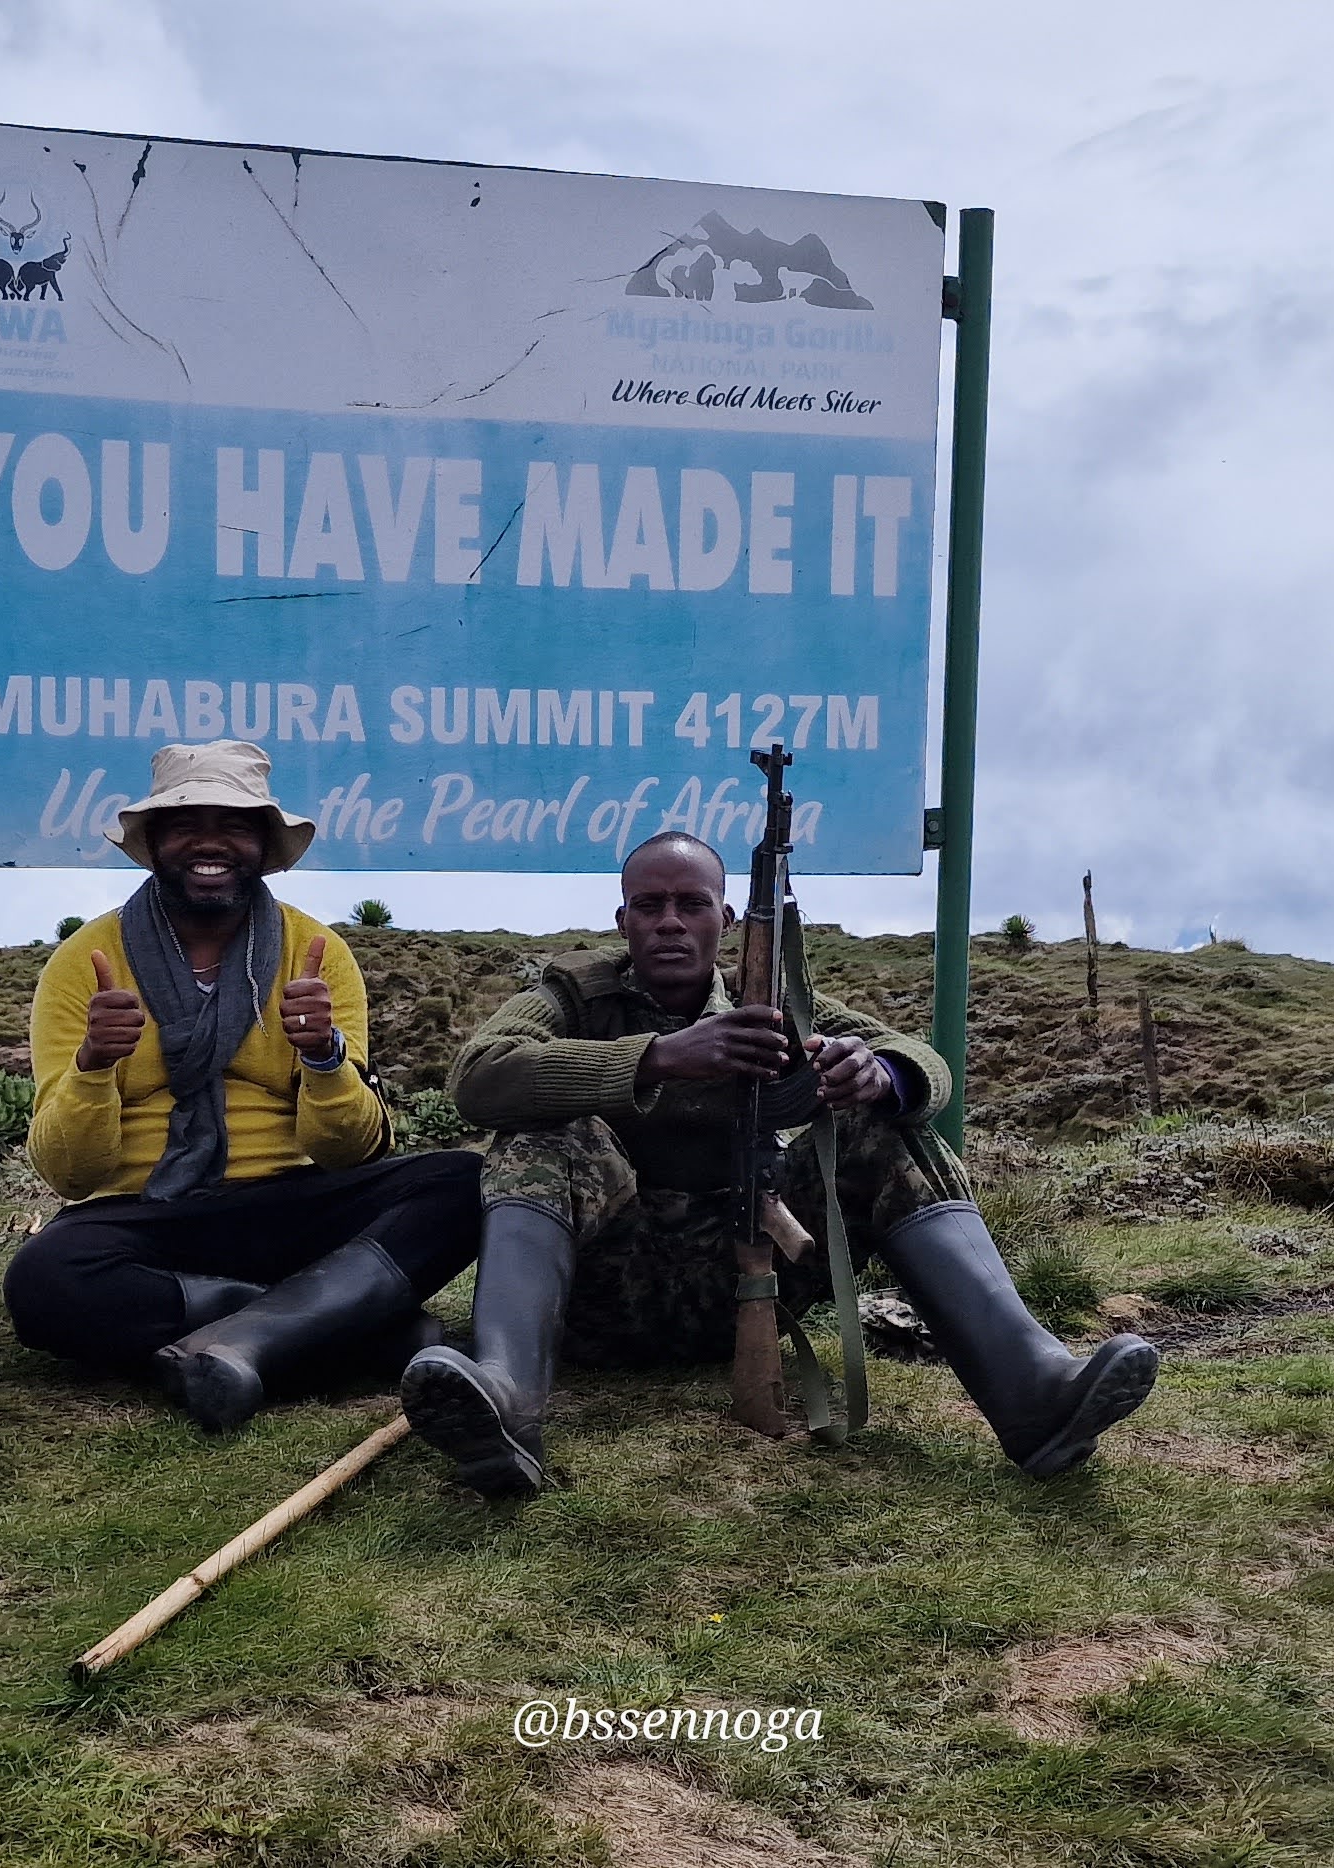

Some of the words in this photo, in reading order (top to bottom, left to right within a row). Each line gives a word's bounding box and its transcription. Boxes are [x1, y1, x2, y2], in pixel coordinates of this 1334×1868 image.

[606, 310, 775, 352] Mgahinga
[611, 379, 689, 405] Where
[695, 383, 751, 409] Gold
[750, 386, 817, 412] Meets
[820, 390, 882, 415] Silver
[216, 447, 483, 585] HAVE
[516, 461, 794, 595] MADE
[829, 475, 913, 597] IT
[390, 685, 654, 747] SUMMIT
[675, 693, 879, 750] 4127M
[319, 773, 403, 841] the
[422, 773, 590, 844] Pearl
[588, 776, 660, 863] of
[658, 775, 823, 845] Afria
